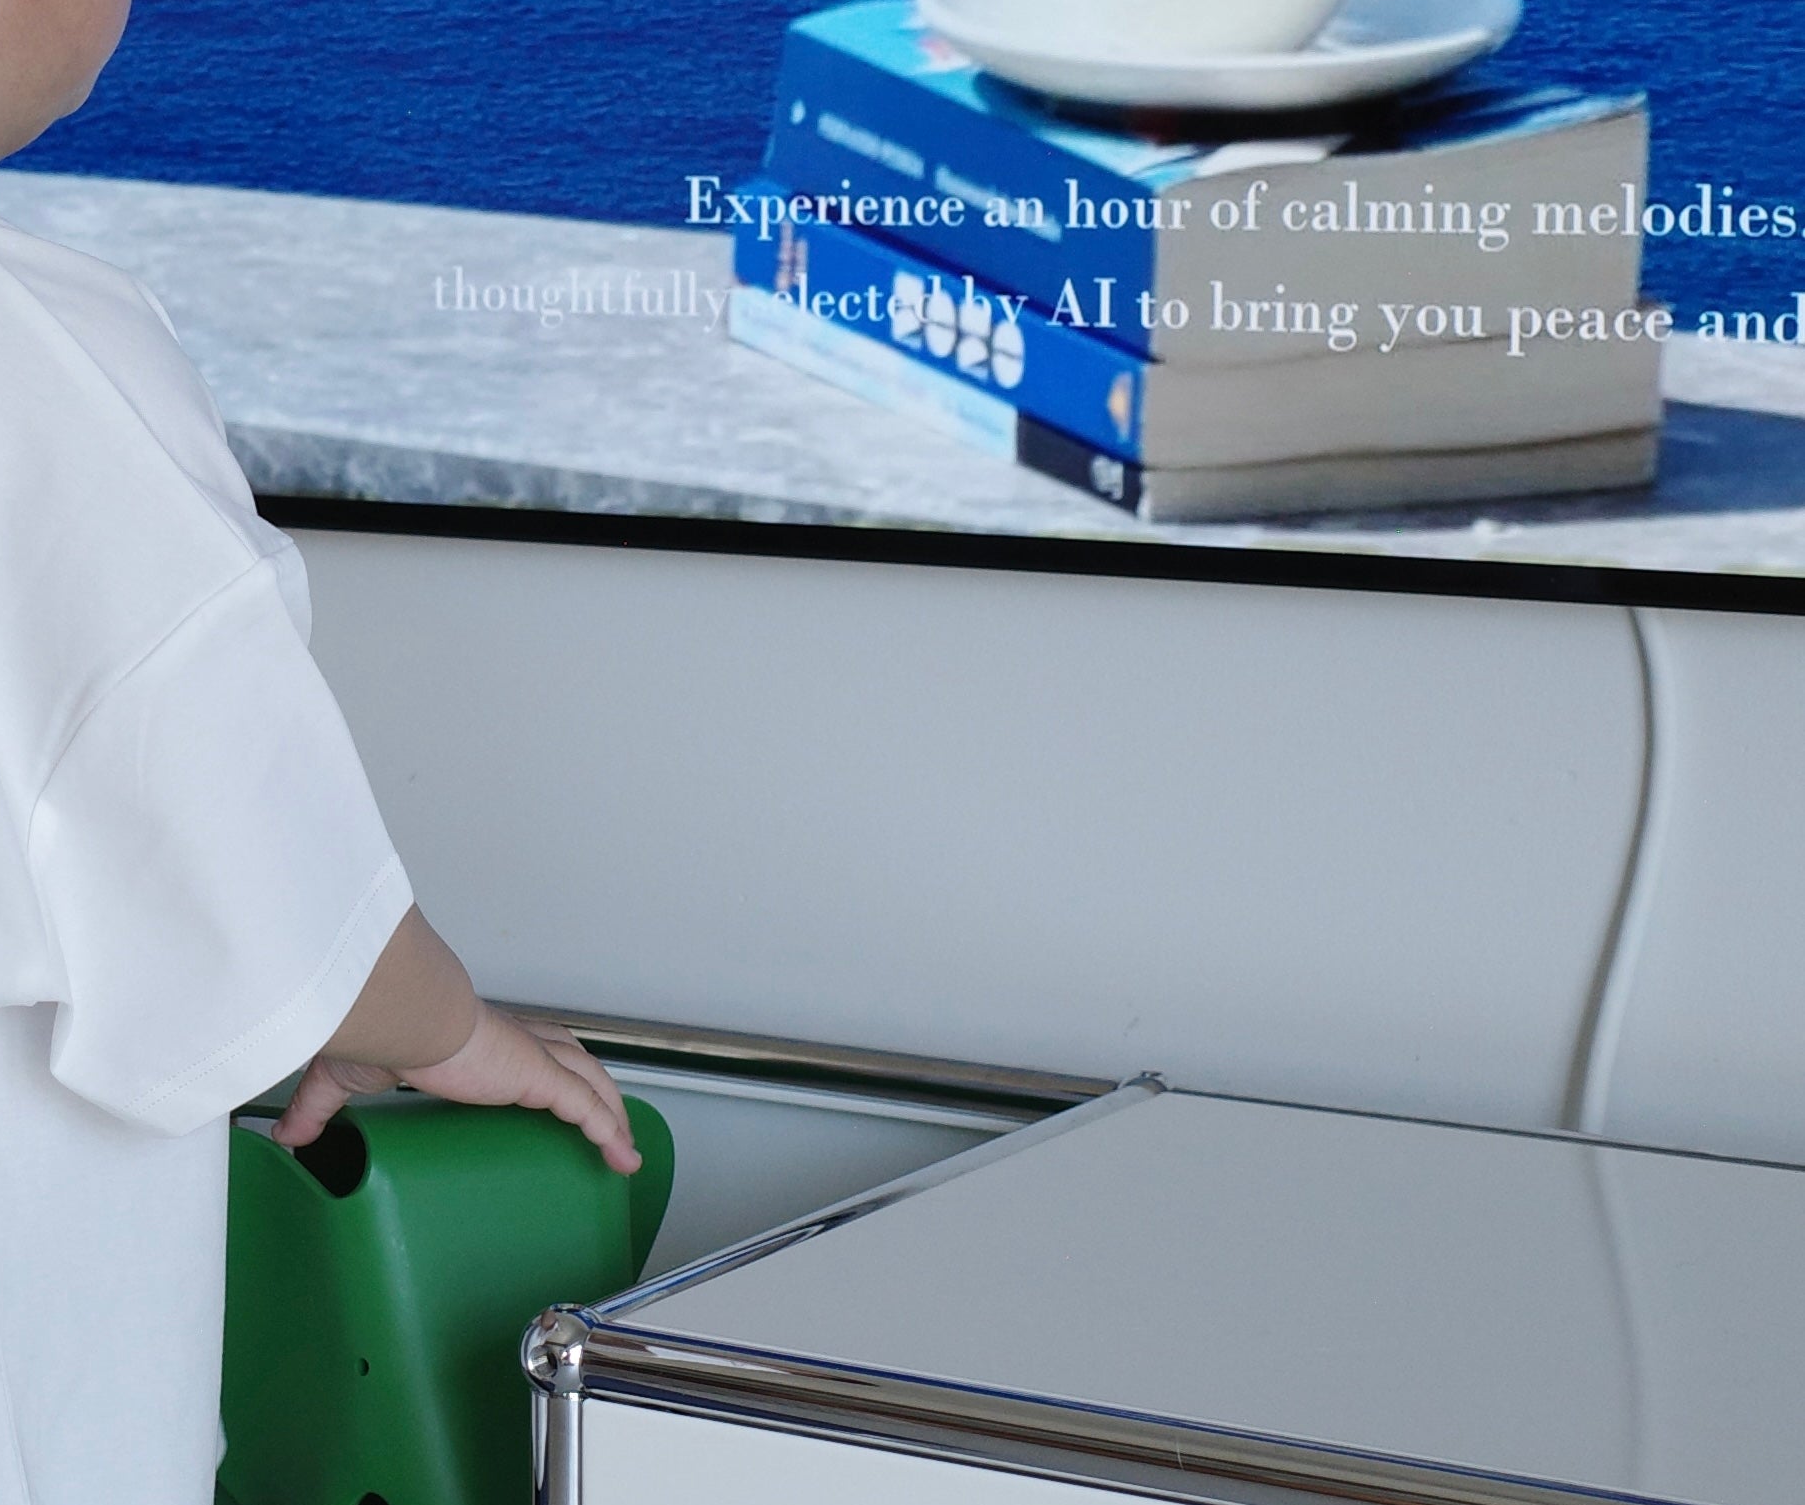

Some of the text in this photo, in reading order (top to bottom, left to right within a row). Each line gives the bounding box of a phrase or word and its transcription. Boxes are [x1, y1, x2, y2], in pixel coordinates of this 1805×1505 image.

[684, 175, 965, 241] Experience
[983, 195, 1045, 228] an
[1064, 178, 1192, 230] hour
[1209, 180, 1269, 232] of
[1282, 181, 1511, 252] calming
[432, 267, 730, 333] thoughtfully
[771, 272, 947, 322] elected
[1046, 277, 1117, 328] AI
[1135, 290, 1190, 330] to
[1210, 280, 1359, 353] bring
[1378, 302, 1487, 353] you
[1507, 305, 1674, 357] peace
[1697, 292, 1805, 344] and
